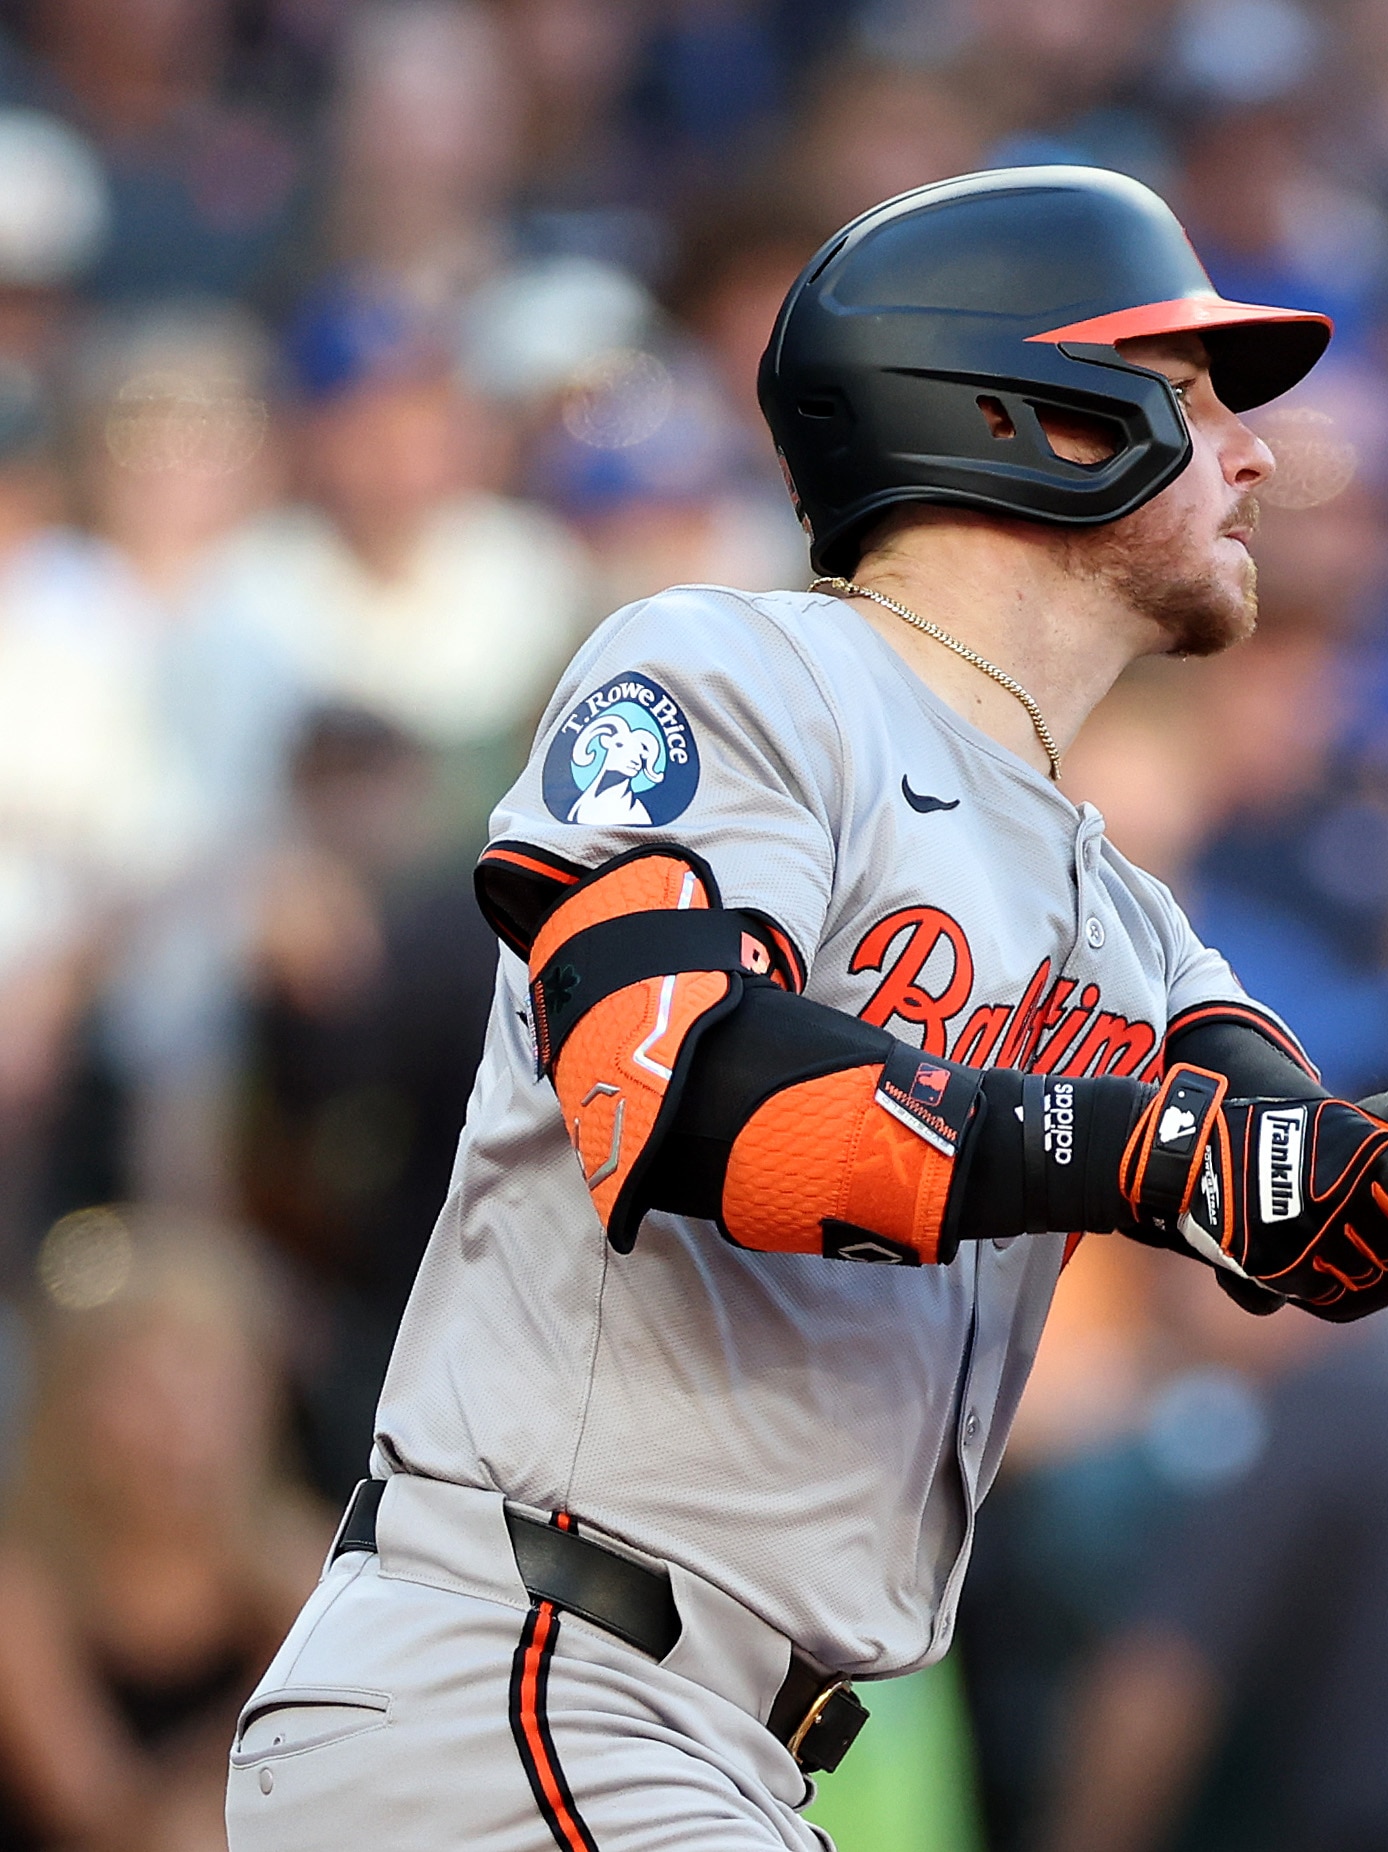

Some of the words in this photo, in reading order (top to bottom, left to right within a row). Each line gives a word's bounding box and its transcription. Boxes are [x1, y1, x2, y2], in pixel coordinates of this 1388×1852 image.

[562, 713, 590, 735] T.
[585, 682, 655, 718] Rowe
[650, 694, 688, 764] Price
[1054, 1083, 1074, 1165] adidas
[1266, 1114, 1301, 1217] Franklin
